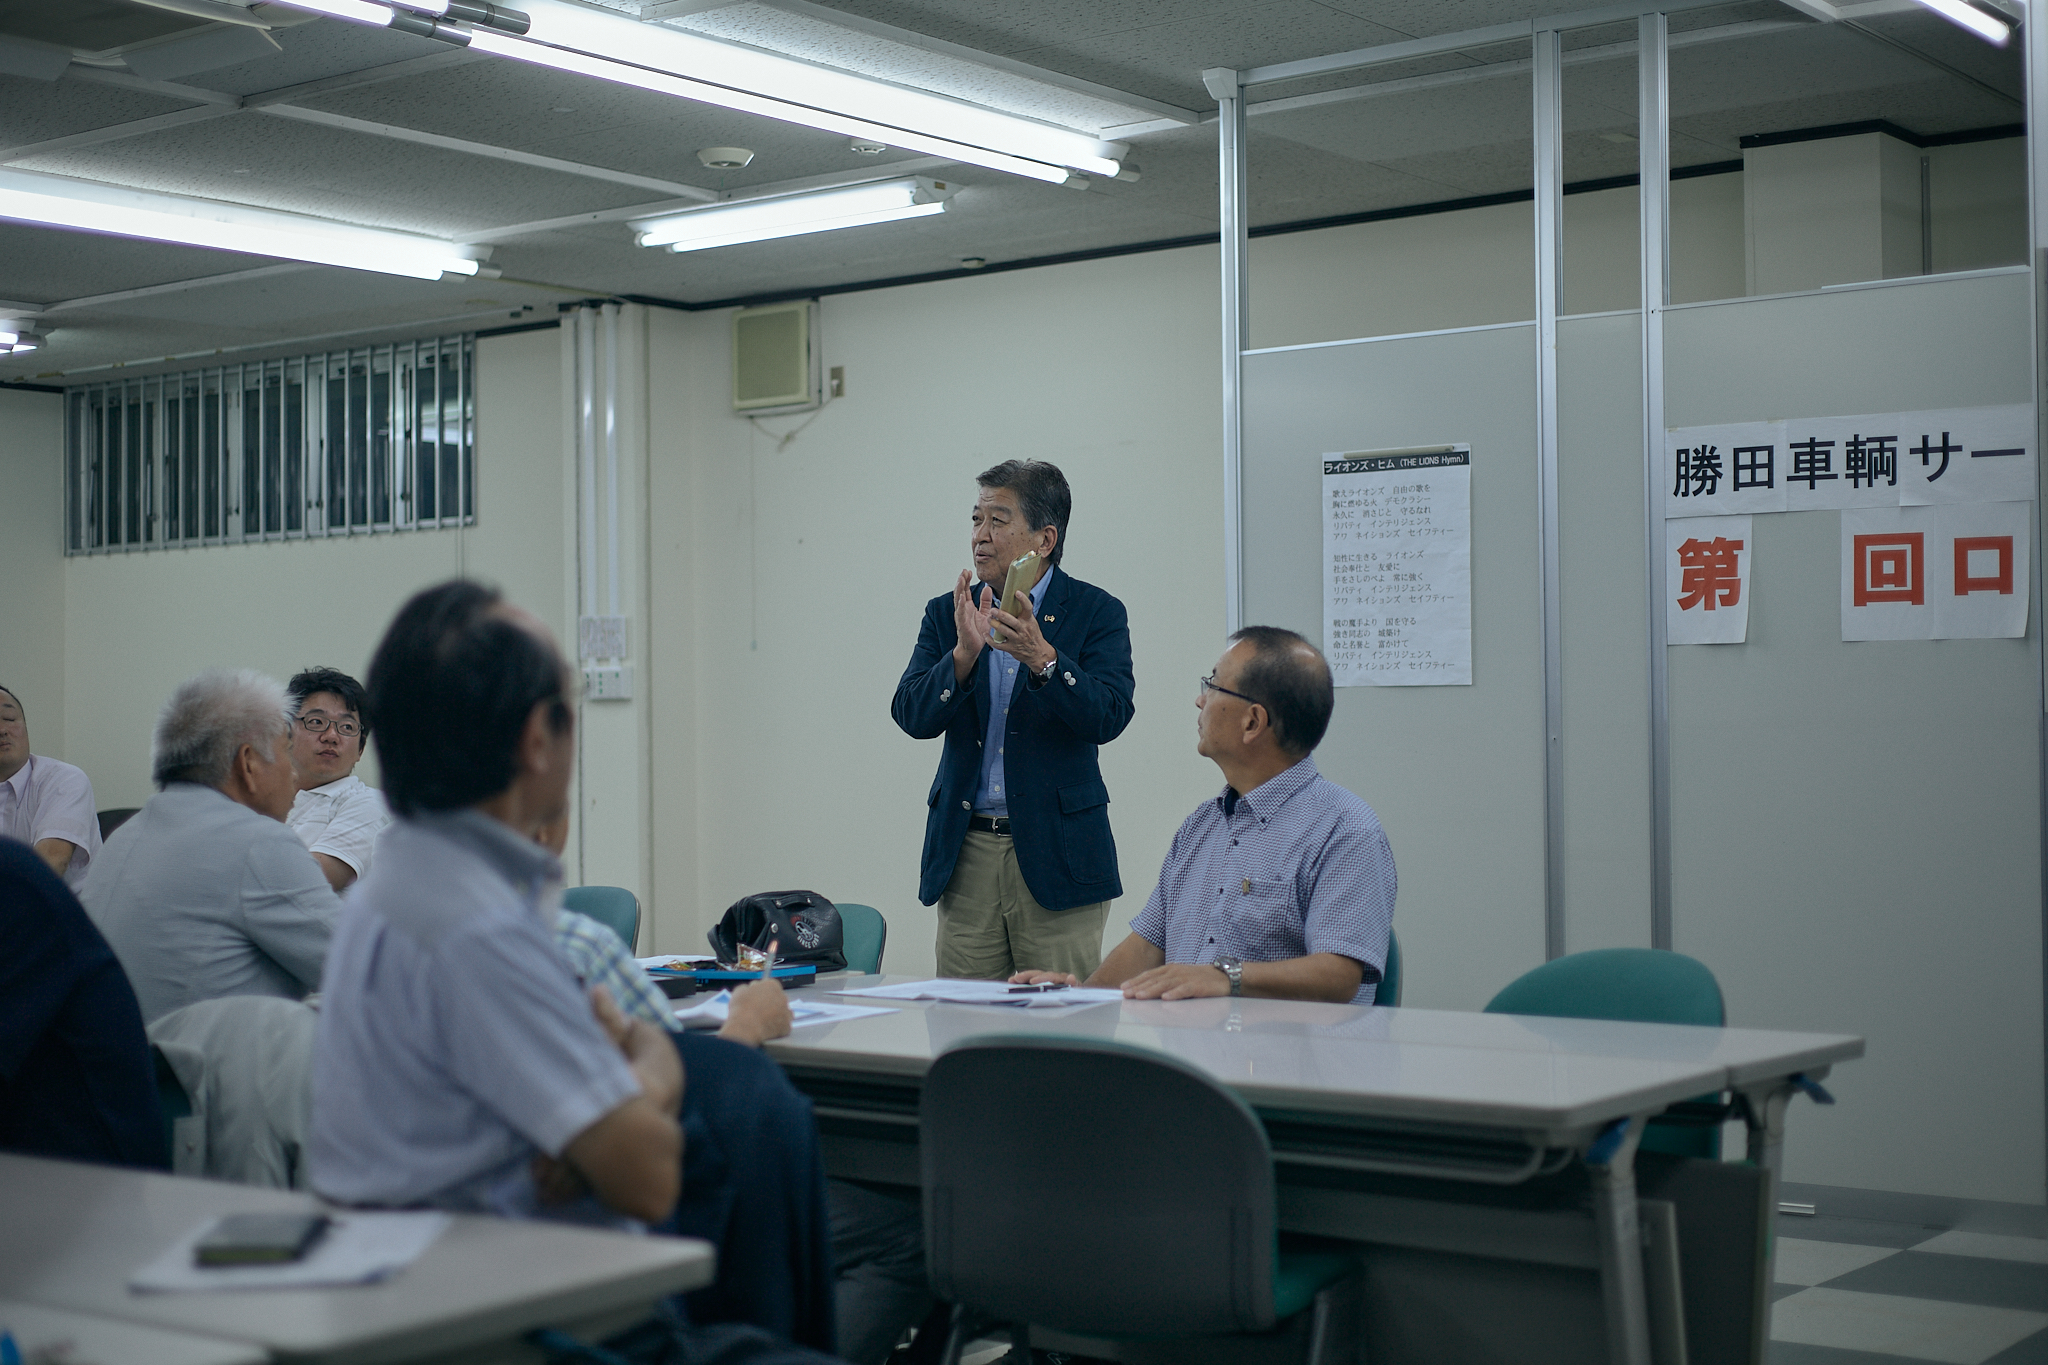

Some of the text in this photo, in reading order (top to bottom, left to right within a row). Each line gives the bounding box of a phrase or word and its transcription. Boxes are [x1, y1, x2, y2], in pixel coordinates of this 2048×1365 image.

[1324, 459, 1395, 473] ライオンズ・ヒム
[1418, 456, 1440, 466] LIONS
[1673, 431, 2026, 498] 勝田車輌サー
[1332, 484, 1431, 498] 歌えライオンズ 自由の歌を
[1384, 496, 1431, 506] デモクラシー
[1370, 517, 1431, 528] インテリジェンス
[1355, 529, 1401, 539] ネイションズ
[1407, 527, 1454, 537] セイフティー
[1333, 550, 1425, 563] 知性に生きる ライオンズ
[1377, 562, 1400, 572] 友愛に
[1676, 536, 1745, 611] 第
[1370, 583, 1432, 594] インテリジェンス
[1356, 595, 1401, 605] ネイションズ
[1408, 594, 1455, 603] セイフティー
[1385, 617, 1417, 626] 国を守る
[1371, 650, 1432, 660] インテリジェンス
[1356, 661, 1401, 670] ネイションズ
[1408, 661, 1455, 670] セイフティー
